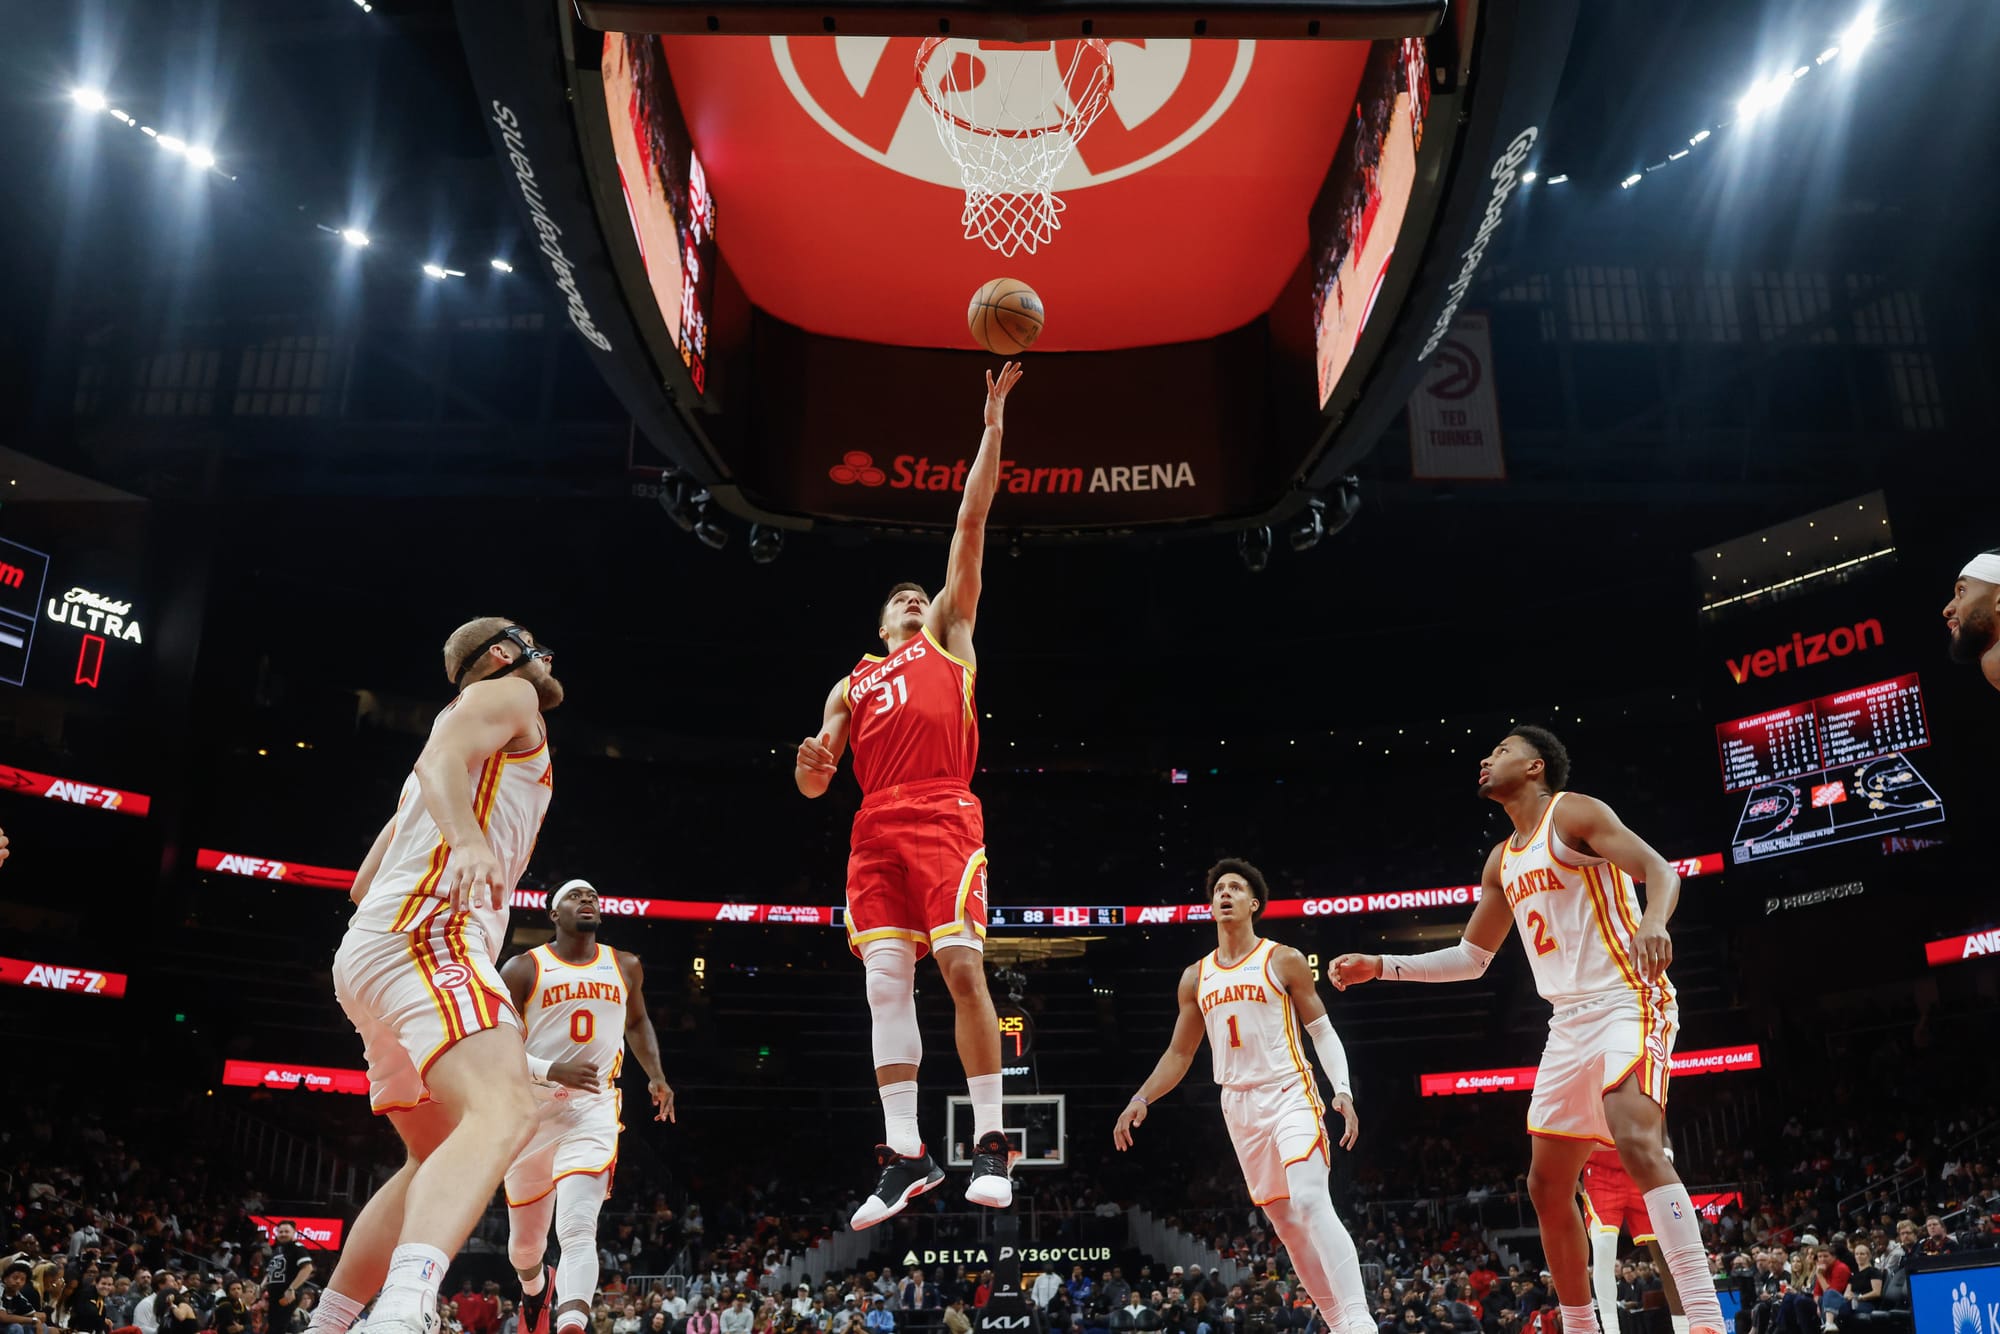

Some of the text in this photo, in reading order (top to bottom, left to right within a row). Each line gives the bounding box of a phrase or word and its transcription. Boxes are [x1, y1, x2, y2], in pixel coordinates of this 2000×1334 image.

[1441, 410, 1466, 426] TED
[1430, 429, 1484, 447] TURNER
[890, 455, 965, 491] Stat
[1089, 461, 1196, 494] ARENA
[47, 598, 142, 644] ULTRA
[1726, 618, 1884, 684] verizon
[850, 640, 926, 704] ROCKETS
[870, 674, 908, 716] 31
[1834, 682, 1897, 704] HOUSTON ROCKETS
[1739, 710, 1790, 729] ATLANTA HAWKS
[1303, 897, 1364, 915] GOOD
[1368, 888, 1468, 911] MORNING
[1505, 867, 1567, 910] TLANTA
[1784, 881, 1864, 909] PRIZEPICKS
[598, 898, 650, 916] ERGY
[715, 904, 758, 921] ANF
[769, 905, 819, 915] ATLANTA
[1023, 910, 1044, 923] 88
[1137, 906, 1177, 923] ANF
[1527, 910, 1558, 956] 2
[541, 981, 621, 1009] ATLANTA
[1201, 984, 1268, 1017] ATLANTA
[570, 1009, 596, 1044] 0
[1226, 1014, 1243, 1049] 1
[1005, 1031, 1022, 1057] 7
[1725, 1052, 1753, 1063] GAME
[1001, 1066, 1030, 1076] SSOT
[924, 1250, 989, 1264] DELTA
[1017, 1247, 1111, 1262] Y360°CLUB
